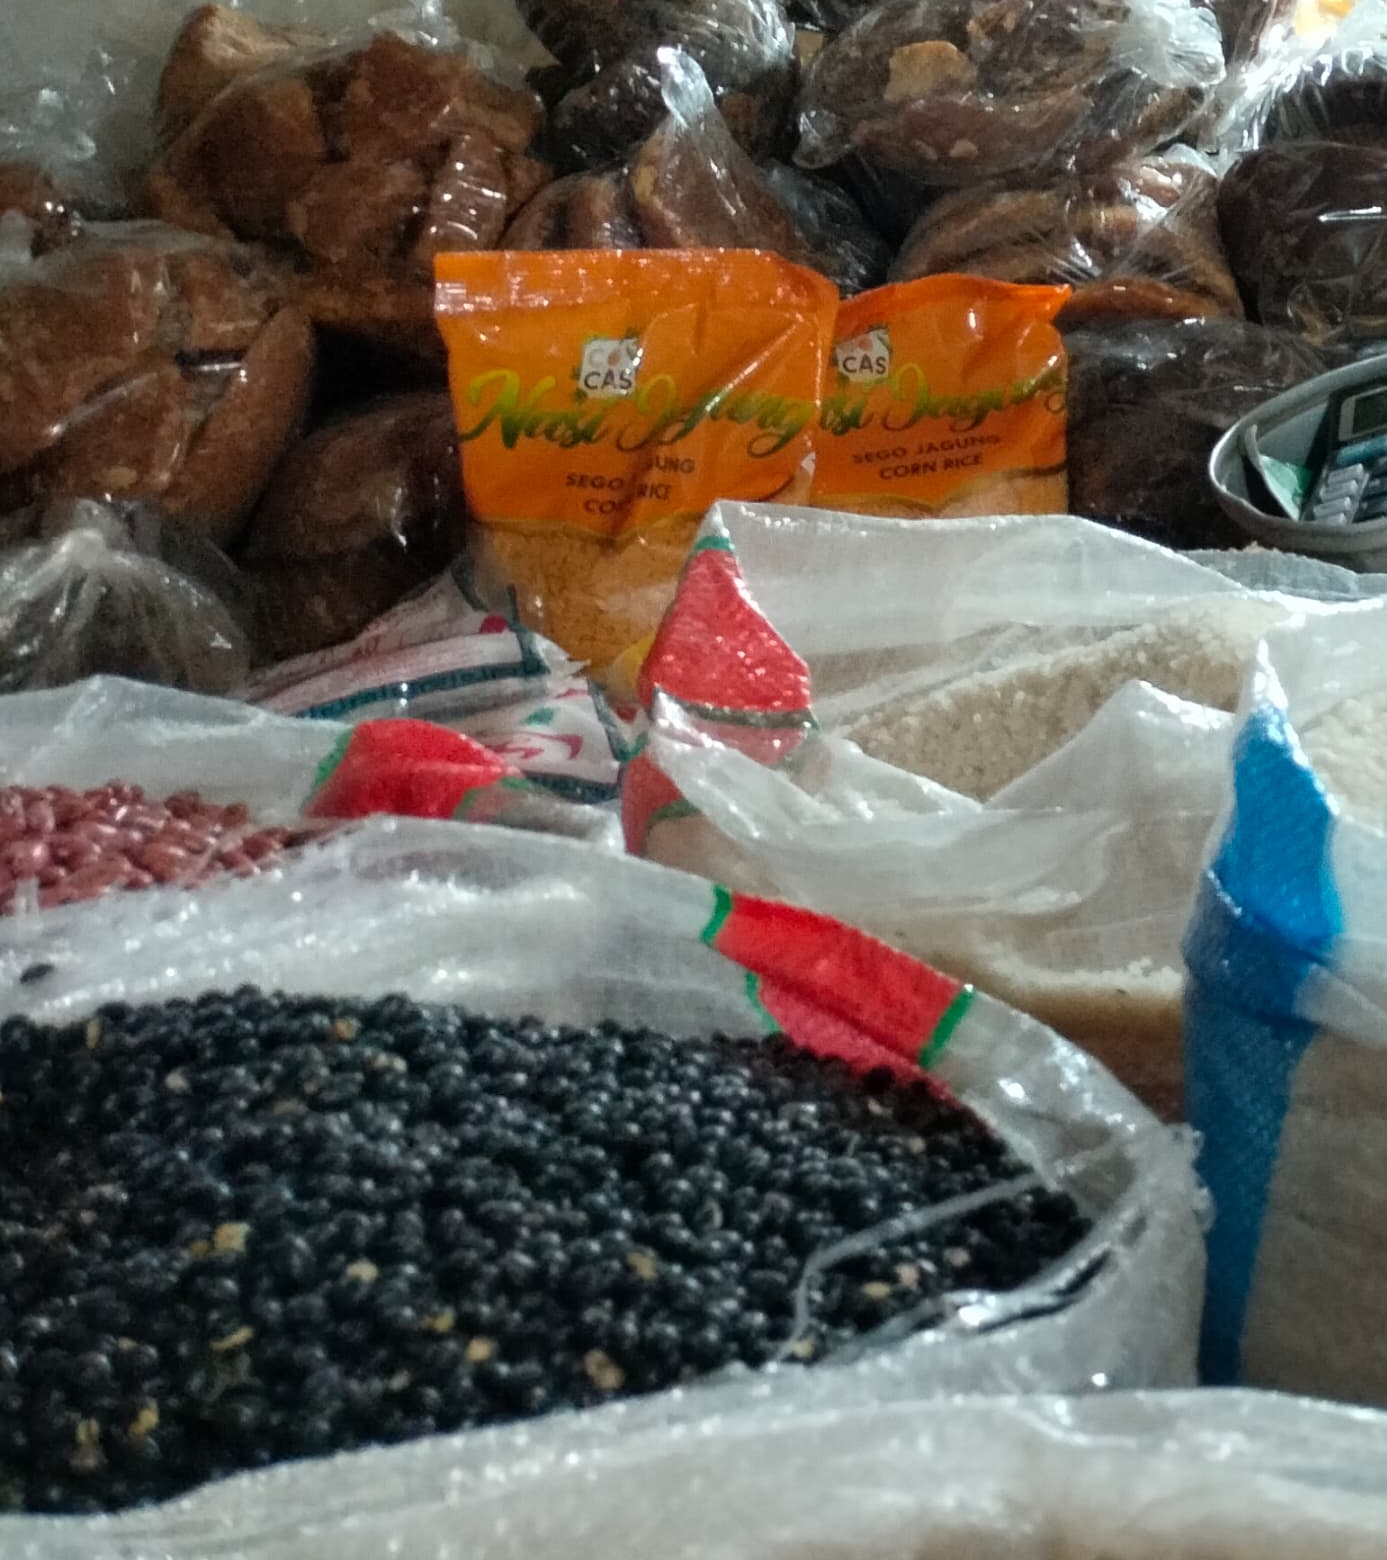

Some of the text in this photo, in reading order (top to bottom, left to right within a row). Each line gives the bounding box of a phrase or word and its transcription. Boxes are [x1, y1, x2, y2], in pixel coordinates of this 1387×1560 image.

[842, 353, 887, 376] CAS
[583, 370, 633, 391] CAS
[458, 368, 610, 449] Nasi
[851, 433, 1002, 465] SEGO JAGUNG
[878, 451, 985, 481] CORN RICE
[565, 473, 625, 489] SEGO
